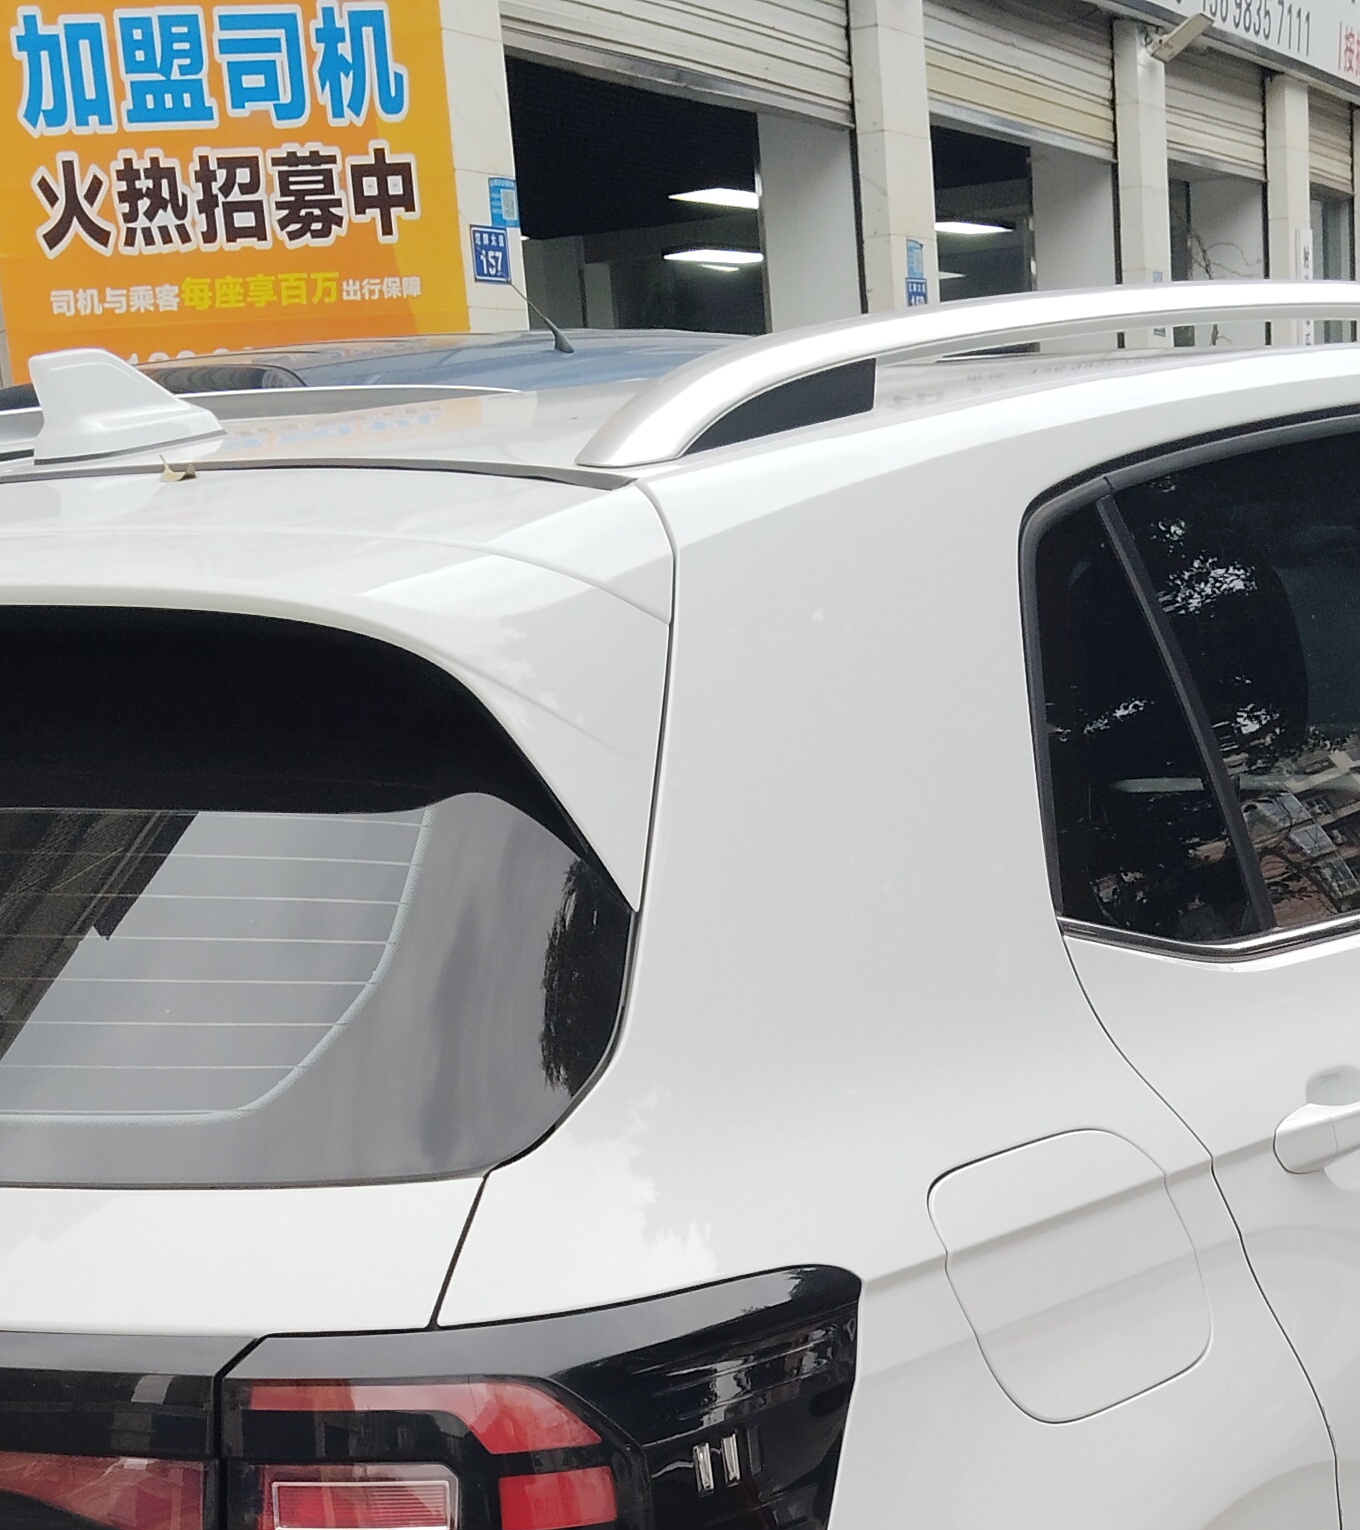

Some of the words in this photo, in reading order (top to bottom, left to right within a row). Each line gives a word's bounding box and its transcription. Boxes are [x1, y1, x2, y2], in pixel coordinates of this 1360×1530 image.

[13, 3, 408, 136] 加盟司机
[34, 140, 420, 259] 火热招募中
[480, 250, 503, 276] 157
